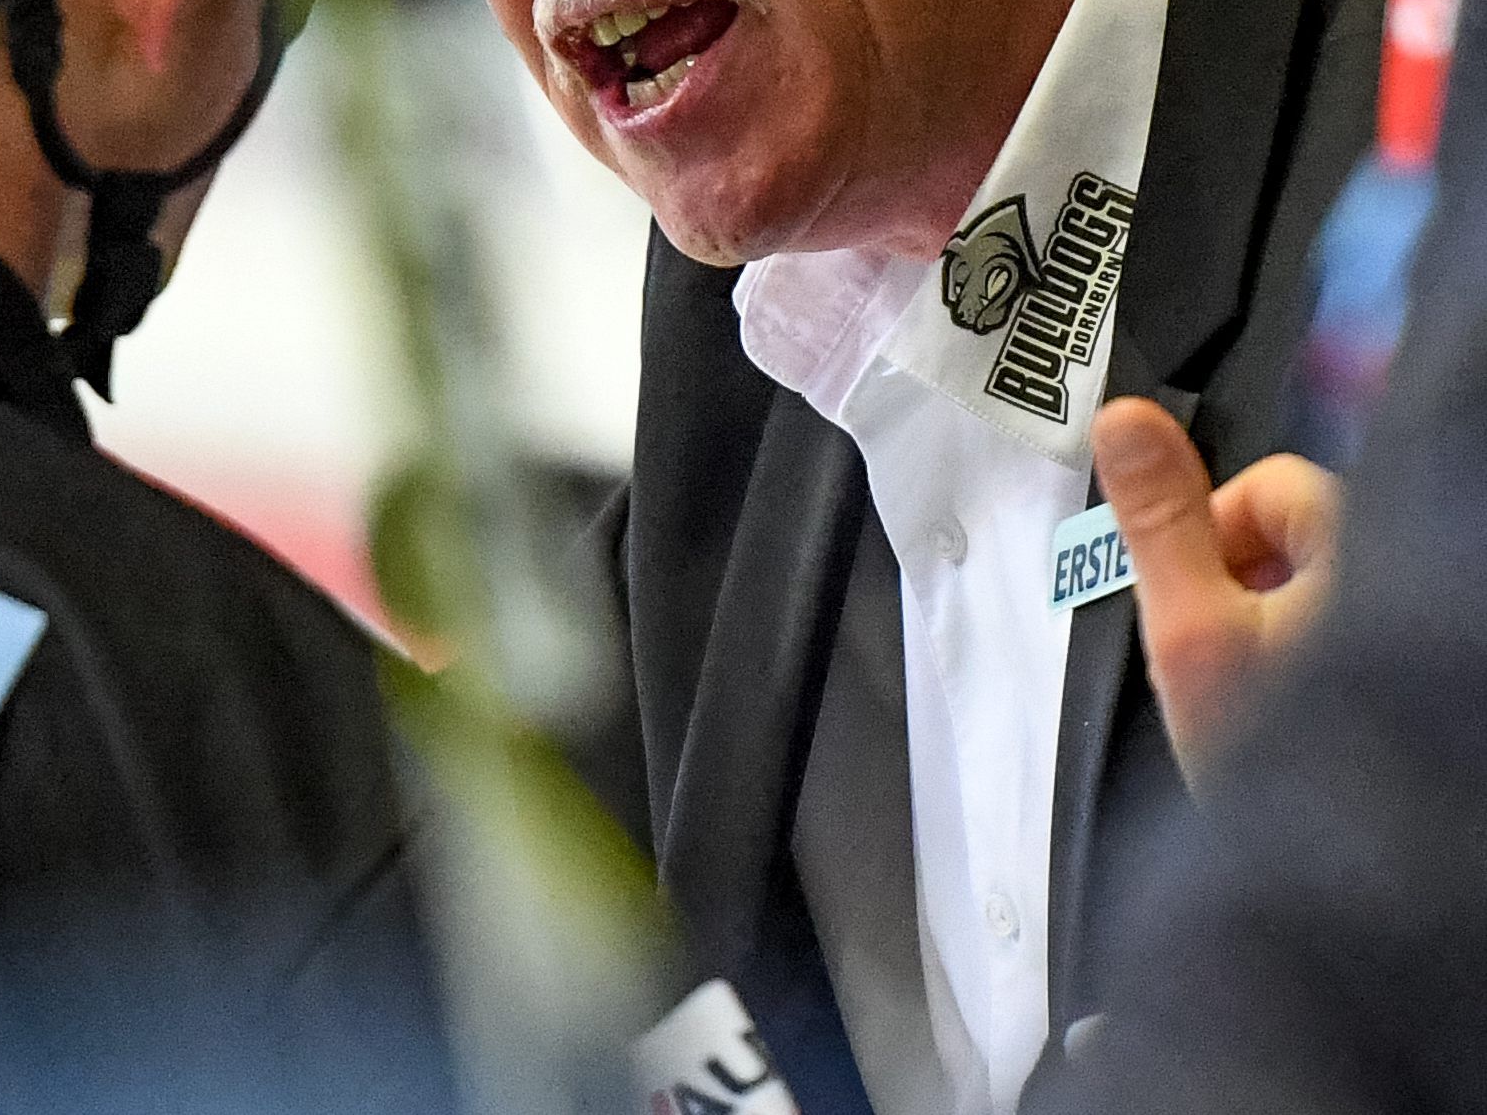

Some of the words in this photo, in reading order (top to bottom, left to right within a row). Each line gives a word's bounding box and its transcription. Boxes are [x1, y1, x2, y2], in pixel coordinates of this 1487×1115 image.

[986, 173, 1137, 422] BULLDOGS
[1069, 256, 1123, 358] DORNBIRN
[1053, 530, 1130, 603] ERSTE
